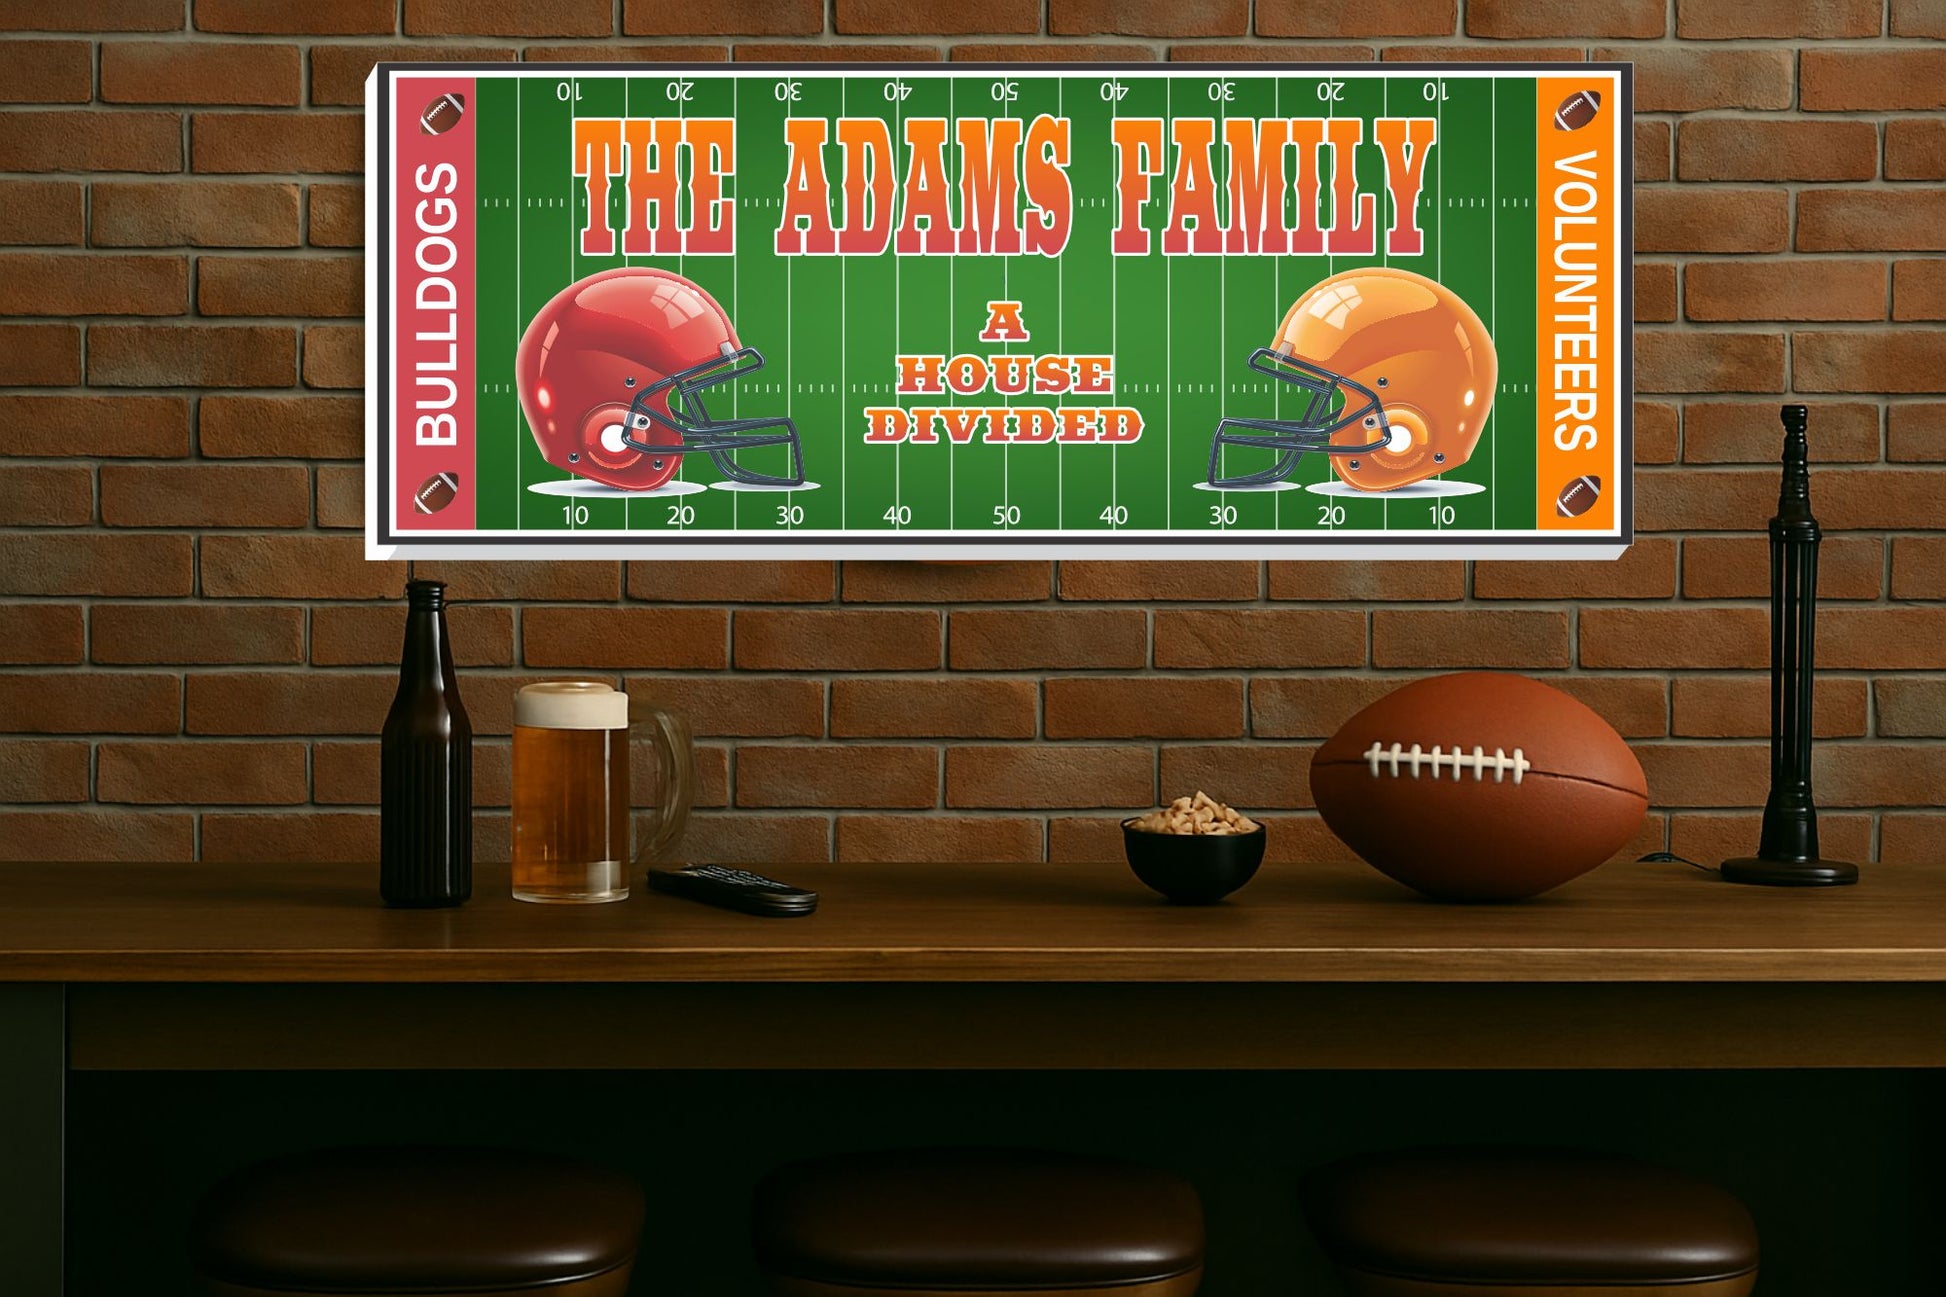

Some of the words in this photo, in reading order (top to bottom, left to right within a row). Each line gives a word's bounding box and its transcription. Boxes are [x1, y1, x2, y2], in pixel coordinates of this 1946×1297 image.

[556, 83, 583, 101] 10
[666, 83, 693, 101] 20
[775, 83, 802, 101] 30
[883, 83, 912, 101] 40
[992, 83, 1018, 101] 50
[1100, 83, 1128, 101] 40
[1208, 83, 1235, 101] 30
[1317, 83, 1344, 101] 20
[1424, 83, 1450, 101] 10
[572, 117, 735, 256] THE
[775, 114, 1073, 257] ADAMS
[1112, 117, 1437, 256] FAMILY
[416, 163, 458, 446] BULLDOGS
[1554, 151, 1597, 451] VOLUNTEERS
[981, 301, 1027, 341] A
[895, 355, 1113, 395] HOUSE
[864, 408, 1145, 444] DIVIDED
[563, 506, 589, 525] 10
[667, 506, 695, 525] 20
[776, 506, 803, 525] 30
[883, 506, 912, 525] 40
[993, 506, 1020, 525] 50
[1099, 506, 1128, 525] 40
[1209, 506, 1237, 525] 30
[1318, 506, 1346, 525] 20
[1429, 506, 1455, 525] 10
